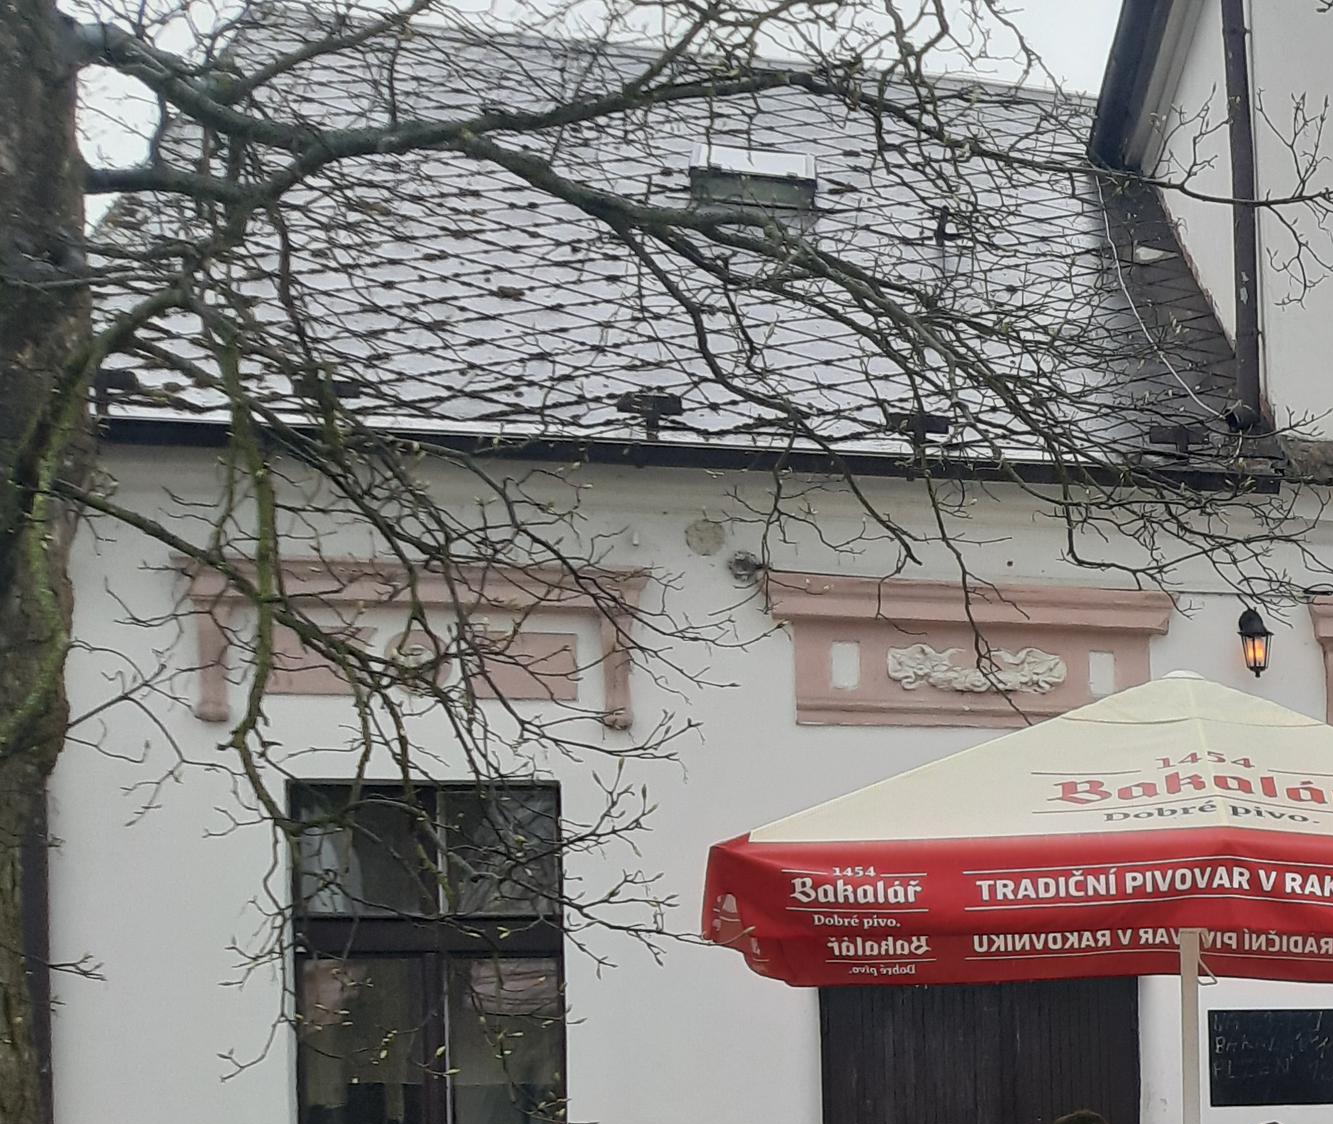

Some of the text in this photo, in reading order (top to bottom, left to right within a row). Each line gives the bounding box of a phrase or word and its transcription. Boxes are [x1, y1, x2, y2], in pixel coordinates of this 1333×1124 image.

[1155, 750, 1255, 769] 1454
[1103, 800, 1321, 825] Dobré pivo.
[833, 866, 876, 877] 1454
[789, 877, 923, 904] Bakalář
[975, 868, 1118, 902] TRADIČNÍ
[1125, 866, 1250, 895] PIVOVAR
[1257, 868, 1278, 892] V
[813, 914, 901, 930] Dobré pivo.
